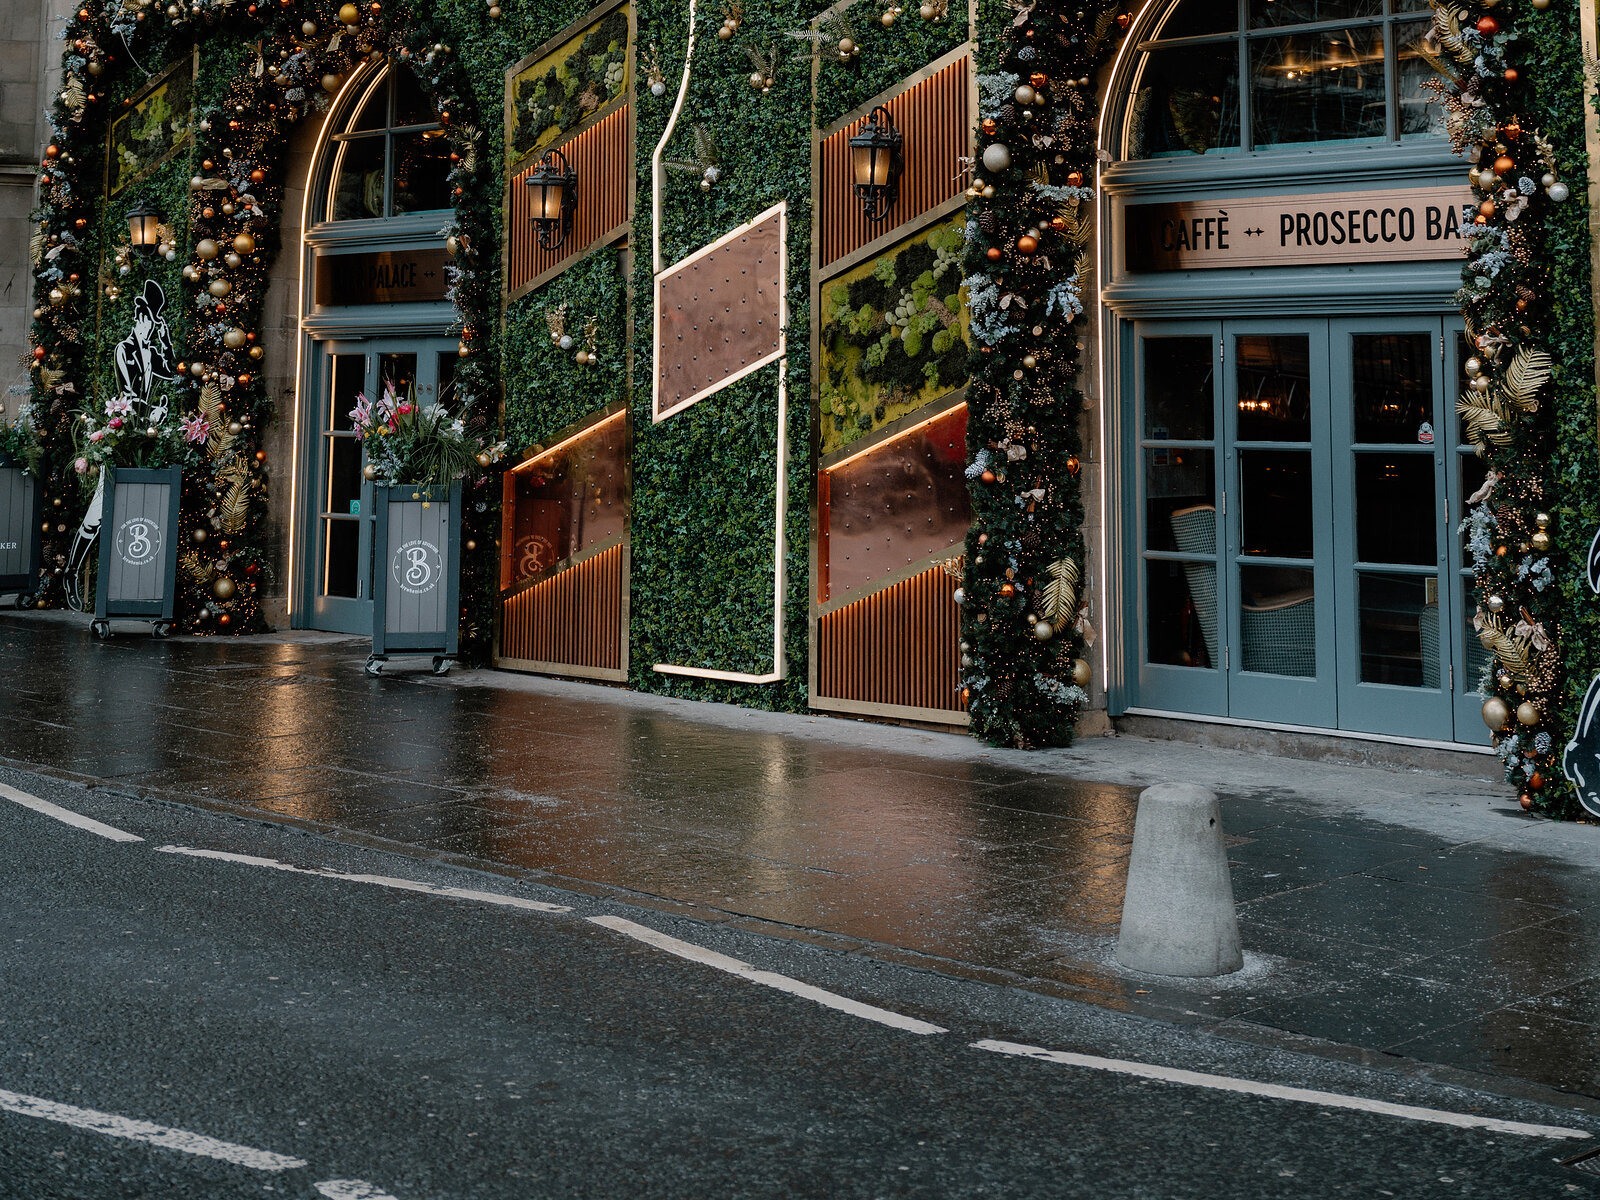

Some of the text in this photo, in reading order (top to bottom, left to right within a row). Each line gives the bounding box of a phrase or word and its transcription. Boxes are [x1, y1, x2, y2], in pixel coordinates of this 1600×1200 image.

[1161, 210, 1230, 250] CAFFÈ
[1280, 207, 1415, 247] PROSECCO
[369, 262, 417, 289] PALACE
[0, 542, 17, 550] KER
[128, 523, 151, 559] B
[406, 547, 431, 586] B
